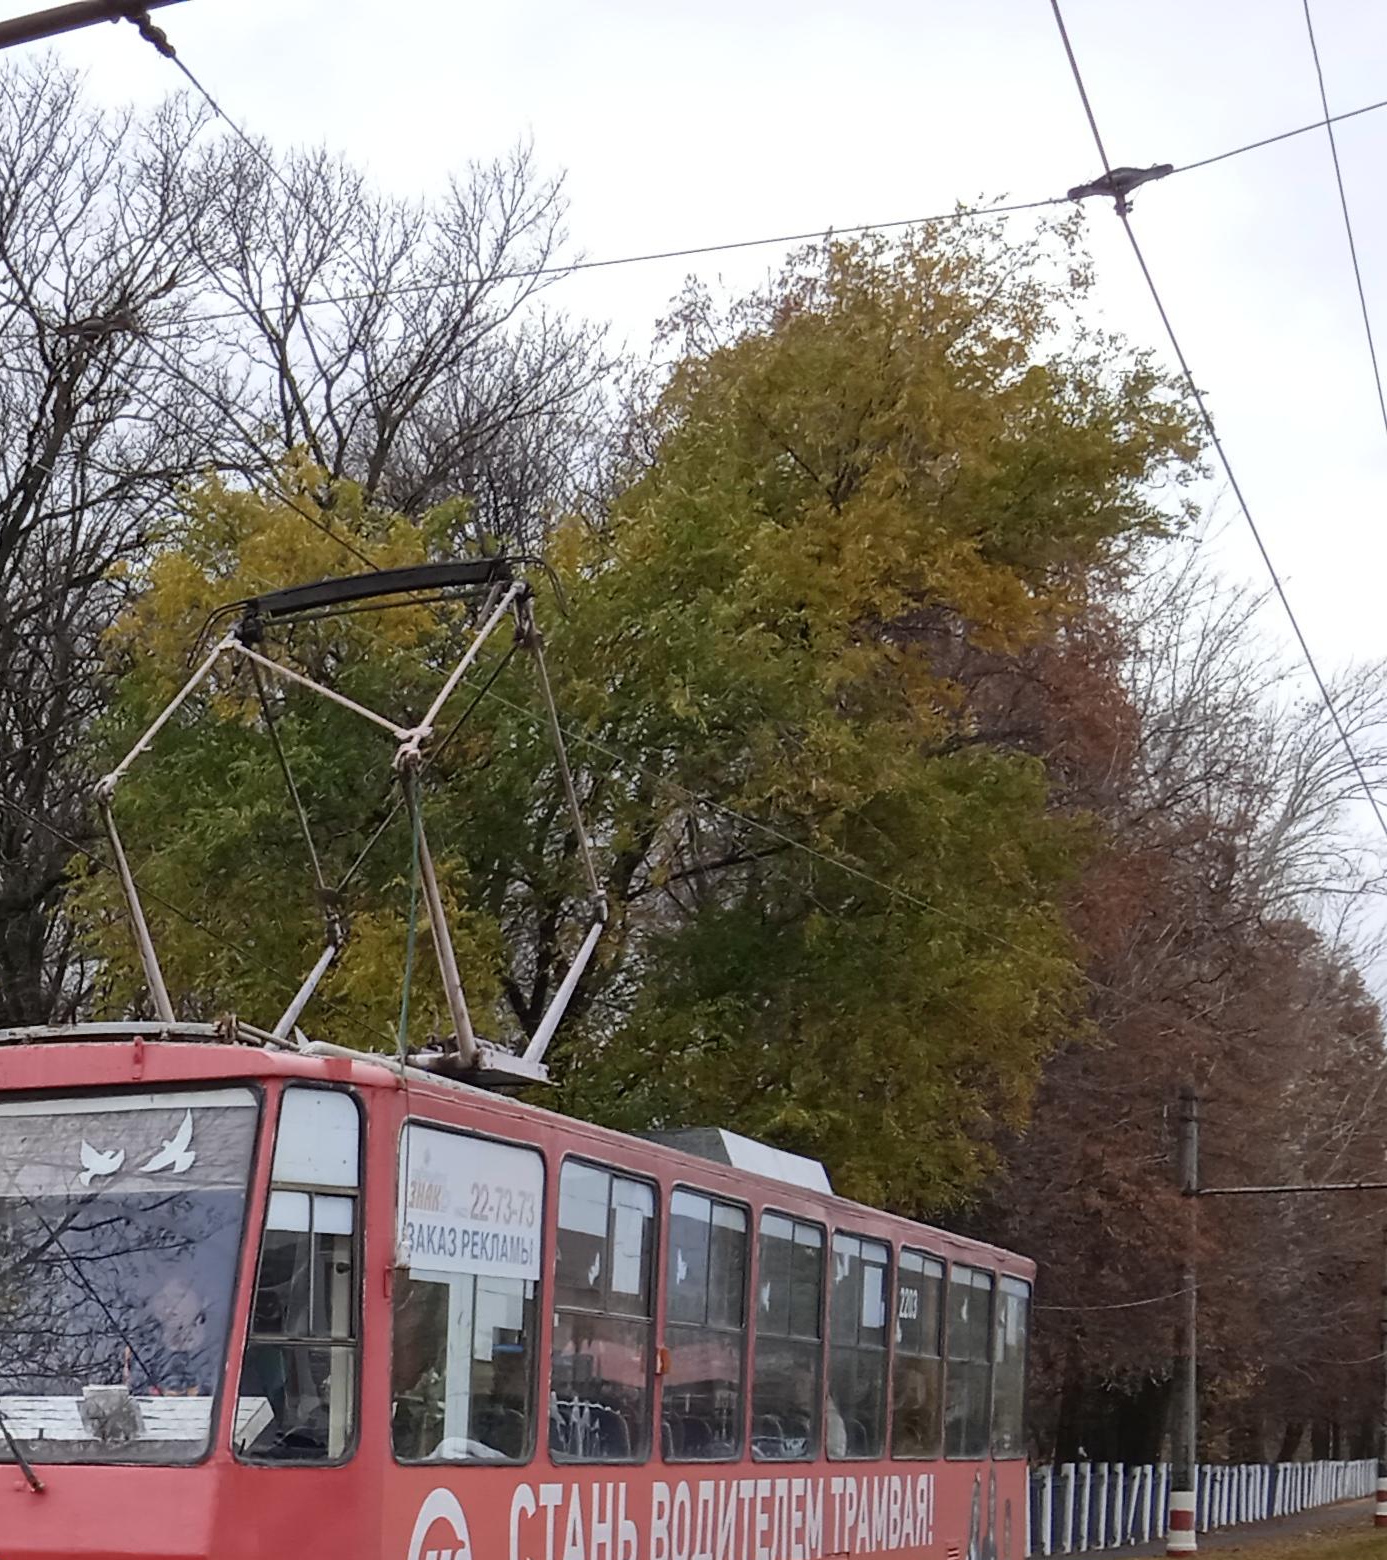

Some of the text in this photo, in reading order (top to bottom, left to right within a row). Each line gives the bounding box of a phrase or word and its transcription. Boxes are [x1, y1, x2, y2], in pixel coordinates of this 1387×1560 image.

[470, 1182, 535, 1228] 22-73-73
[403, 1222, 534, 1265] ЗАКАЗ РЕКЛАМЫ
[831, 1474, 935, 1554] ТРАМВАЯ!
